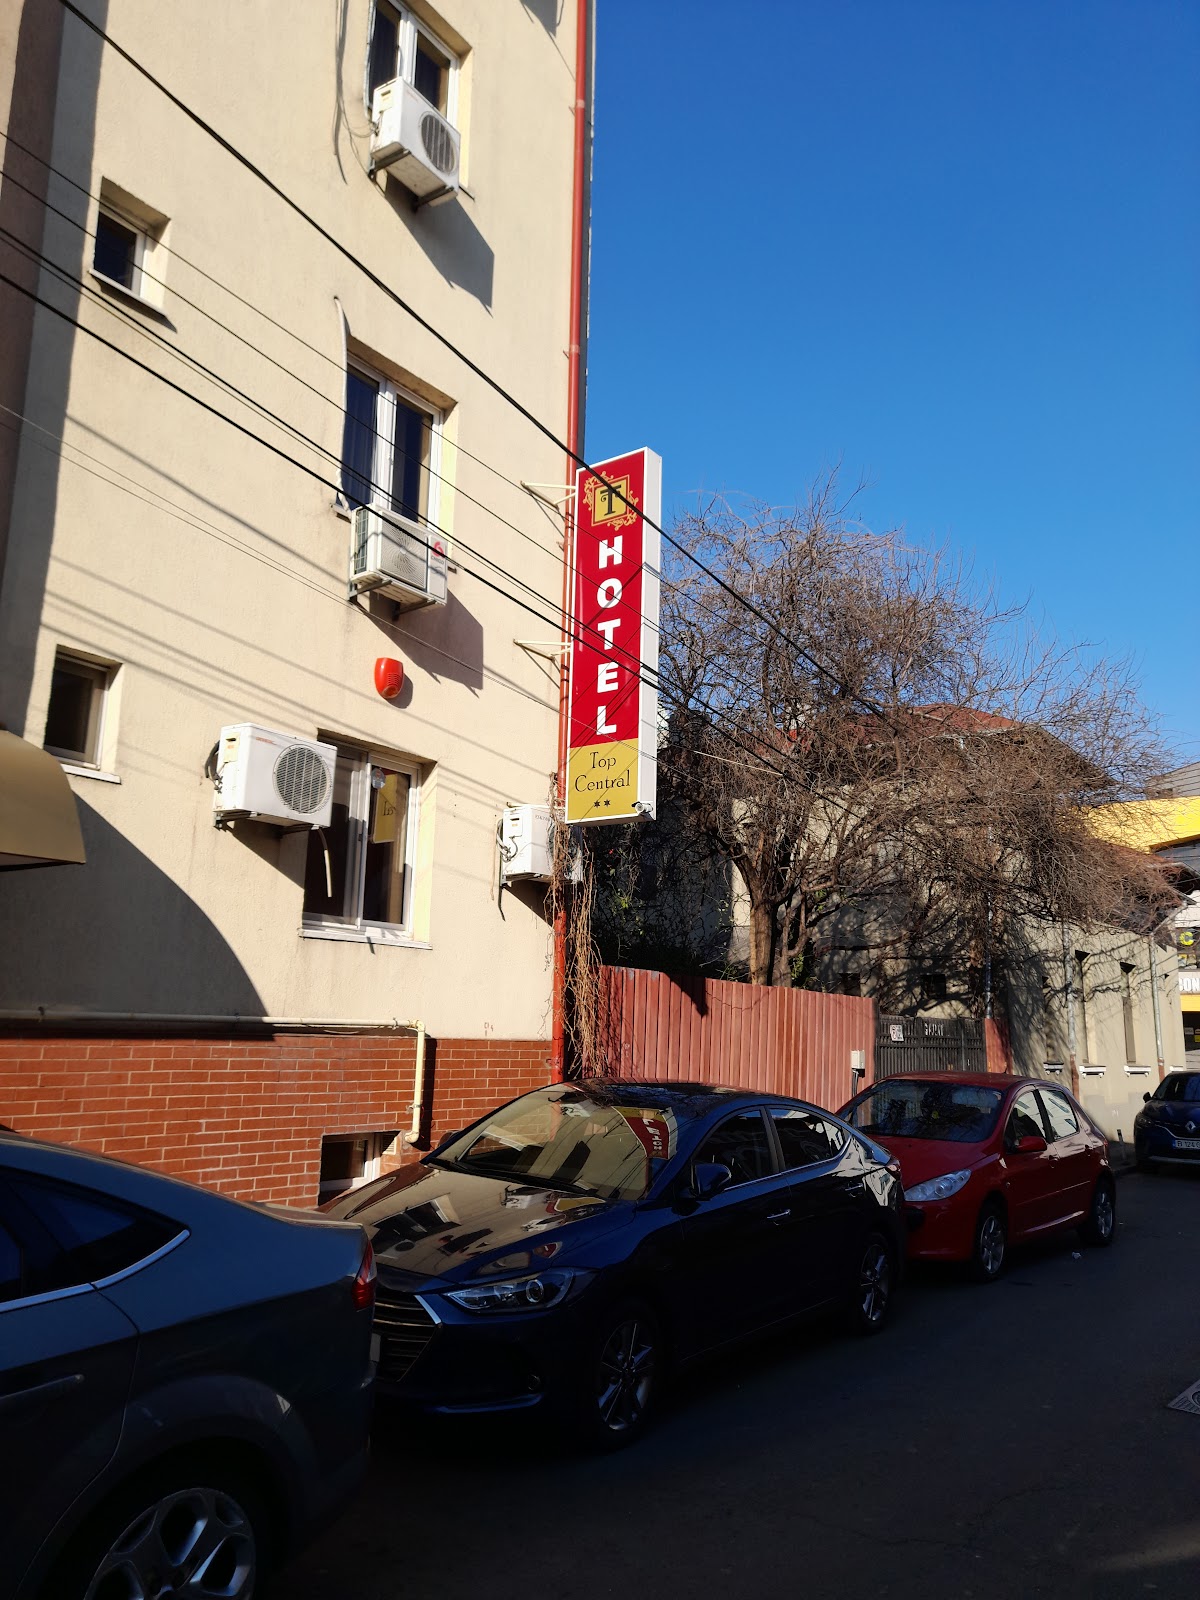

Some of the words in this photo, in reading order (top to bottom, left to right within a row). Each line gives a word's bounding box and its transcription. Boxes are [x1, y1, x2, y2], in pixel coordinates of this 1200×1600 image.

[599, 484, 622, 516] T
[597, 535, 623, 735] HOTEL
[590, 751, 617, 771] Top
[574, 770, 631, 792] Central
